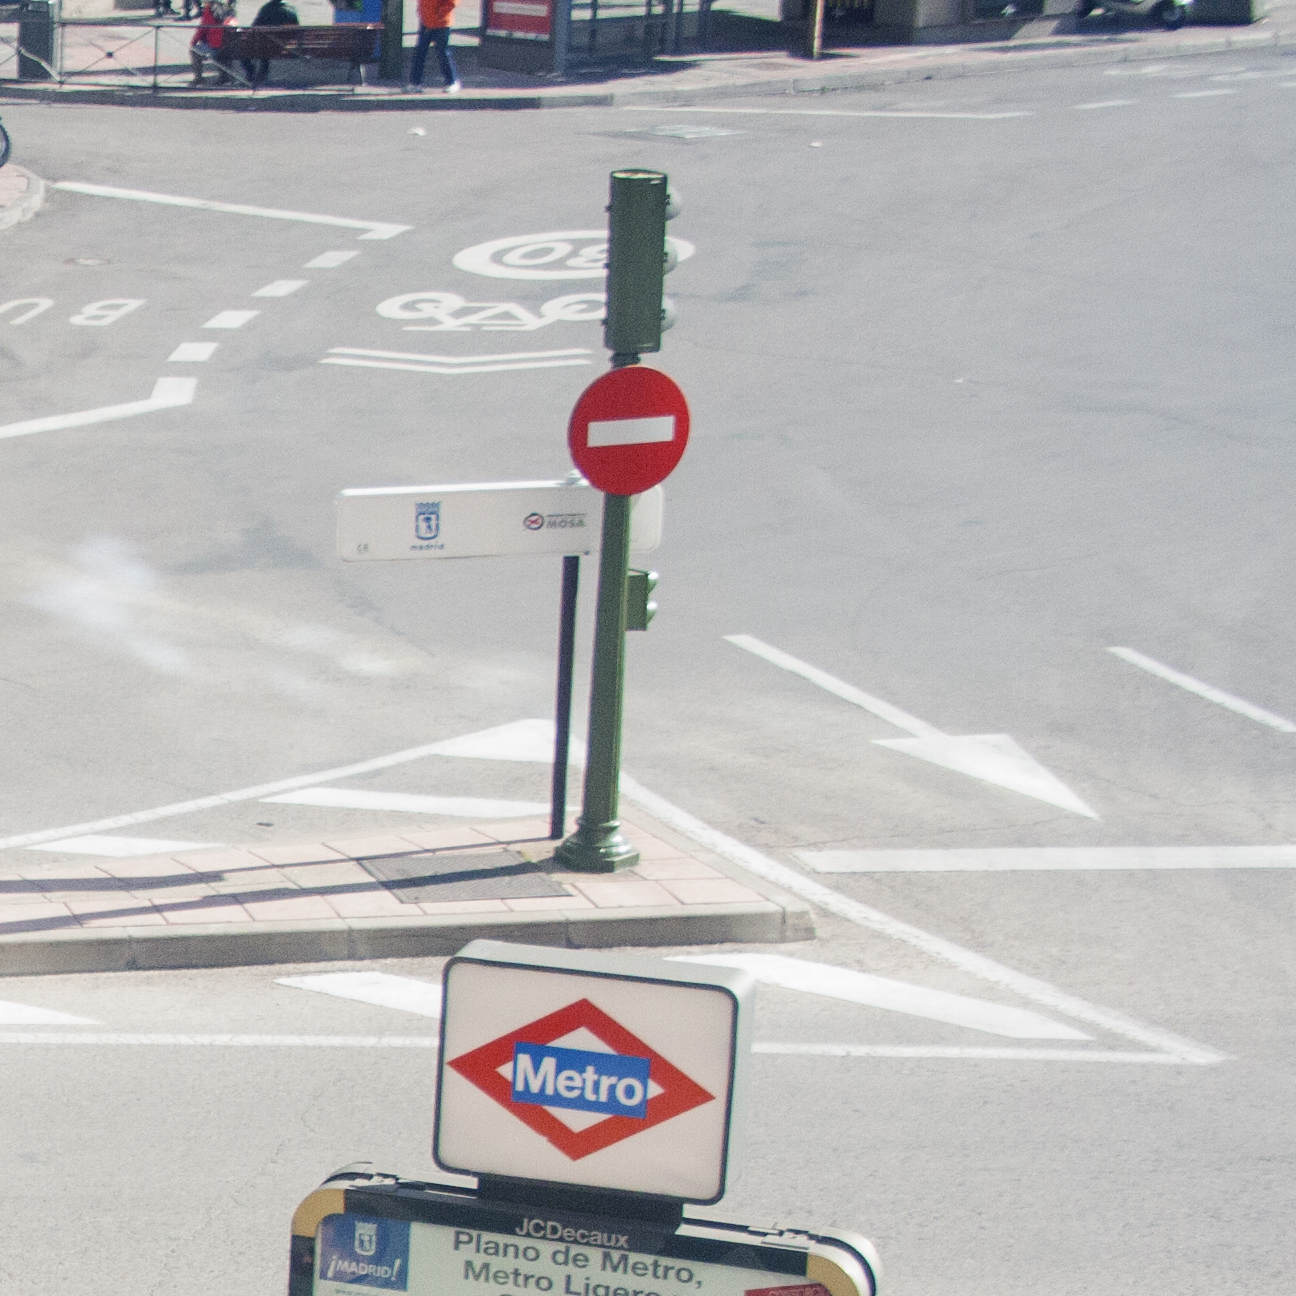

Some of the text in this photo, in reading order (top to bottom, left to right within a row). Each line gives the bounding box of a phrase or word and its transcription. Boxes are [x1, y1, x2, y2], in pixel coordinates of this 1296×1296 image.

[514, 1053, 644, 1106] Metro
[515, 1218, 630, 1249] JCDecaux
[327, 1255, 401, 1281] ¡MADRID!
[454, 1231, 703, 1289] Plano de Metro,
[463, 1259, 553, 1292] Metro
